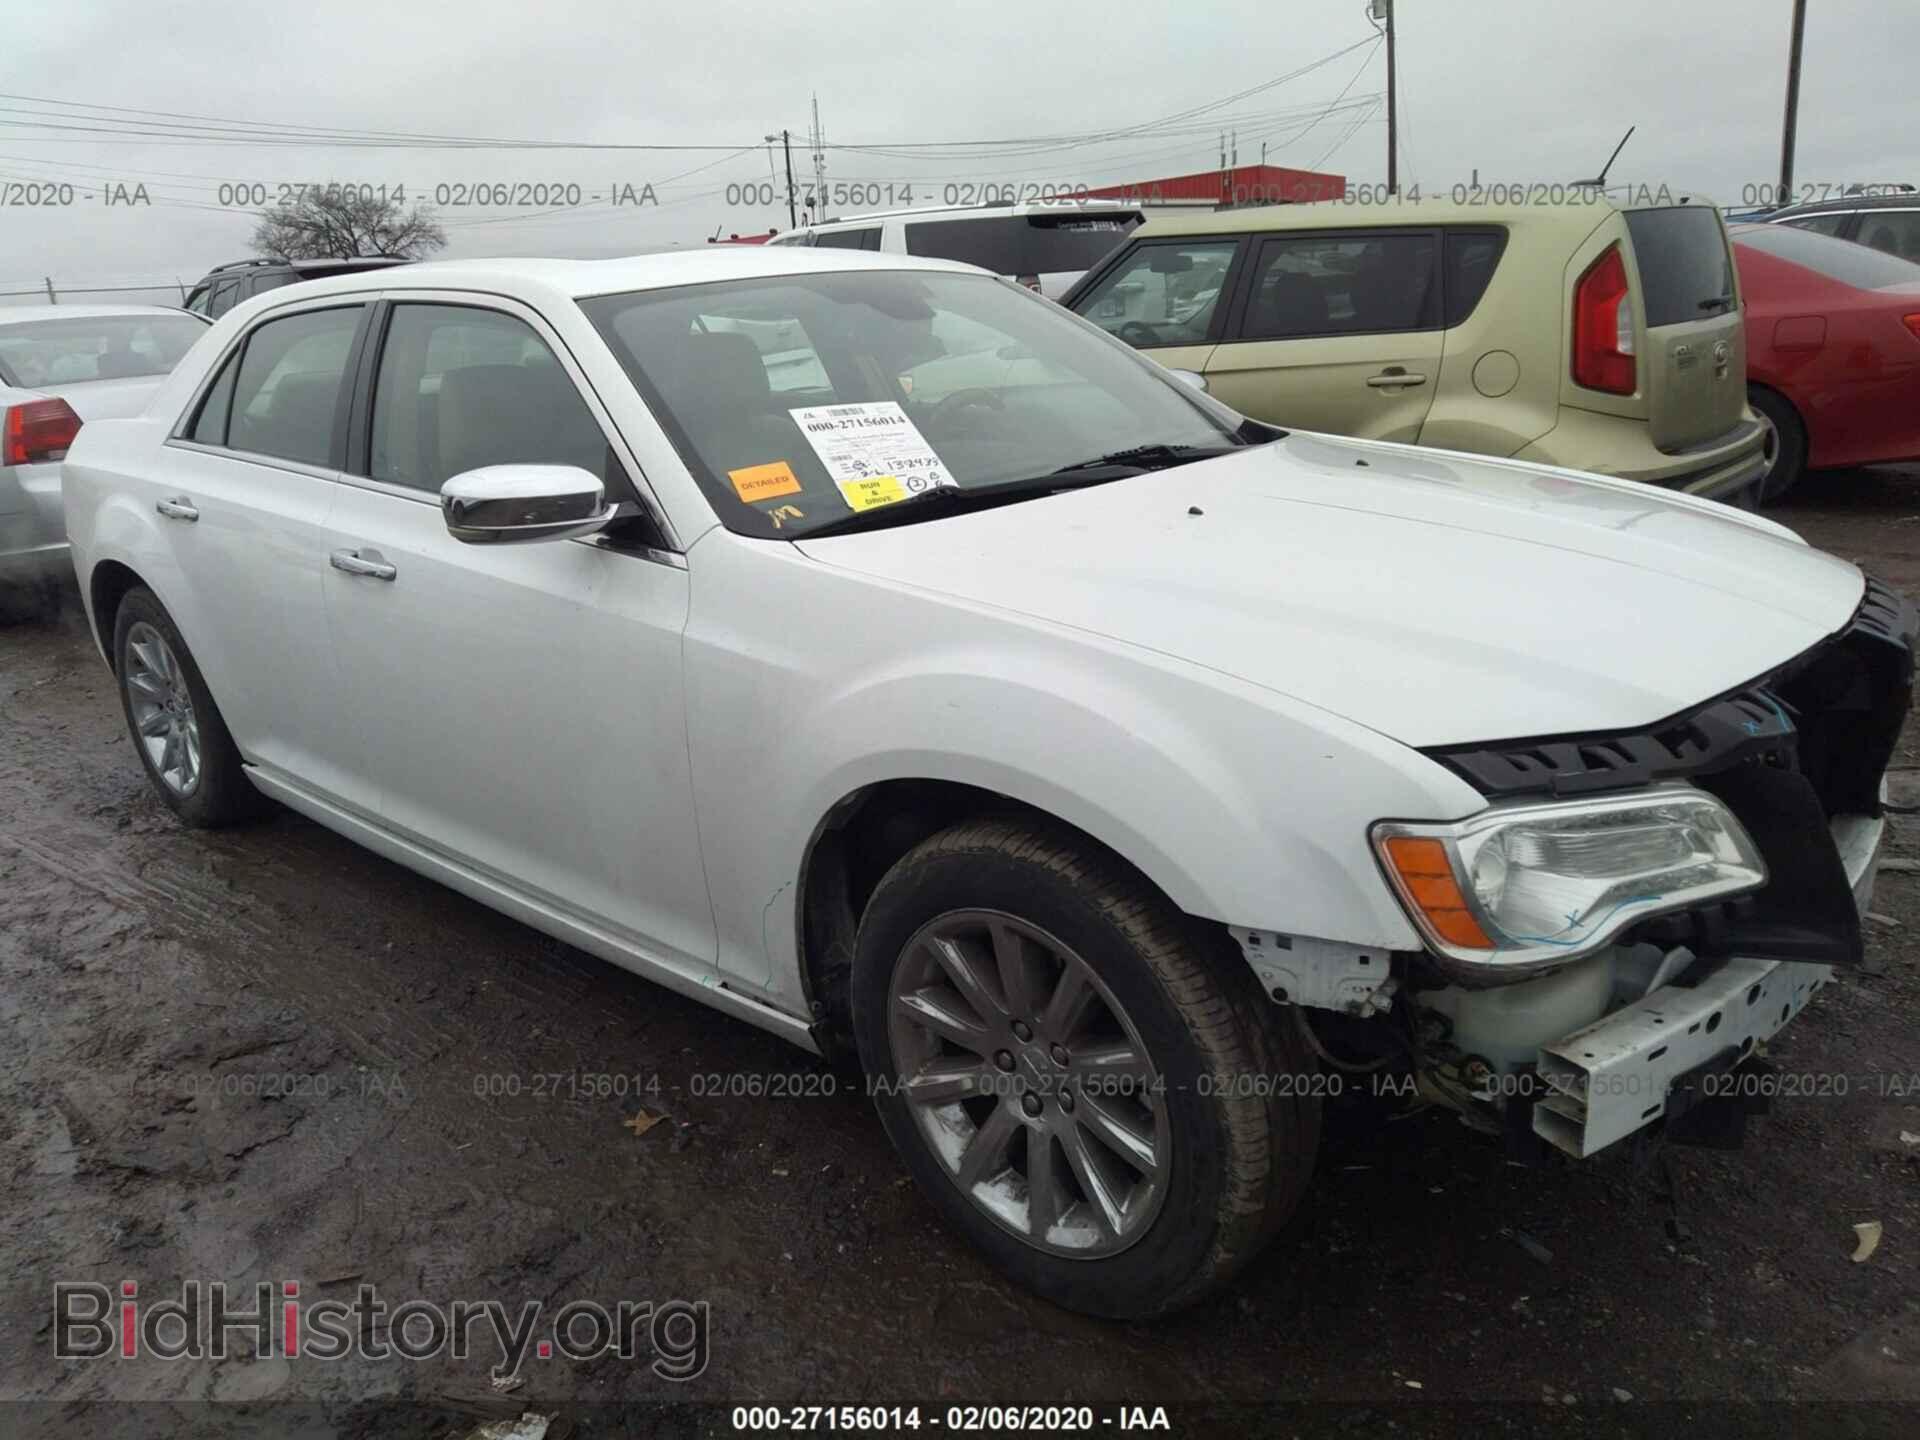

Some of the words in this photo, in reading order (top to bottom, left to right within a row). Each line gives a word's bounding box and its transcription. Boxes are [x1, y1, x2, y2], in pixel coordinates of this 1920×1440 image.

[807, 415, 905, 433] 000-27156014
[741, 476, 789, 490] DETAILED
[860, 482, 881, 490] RUN
[865, 496, 892, 506] DRIVE
